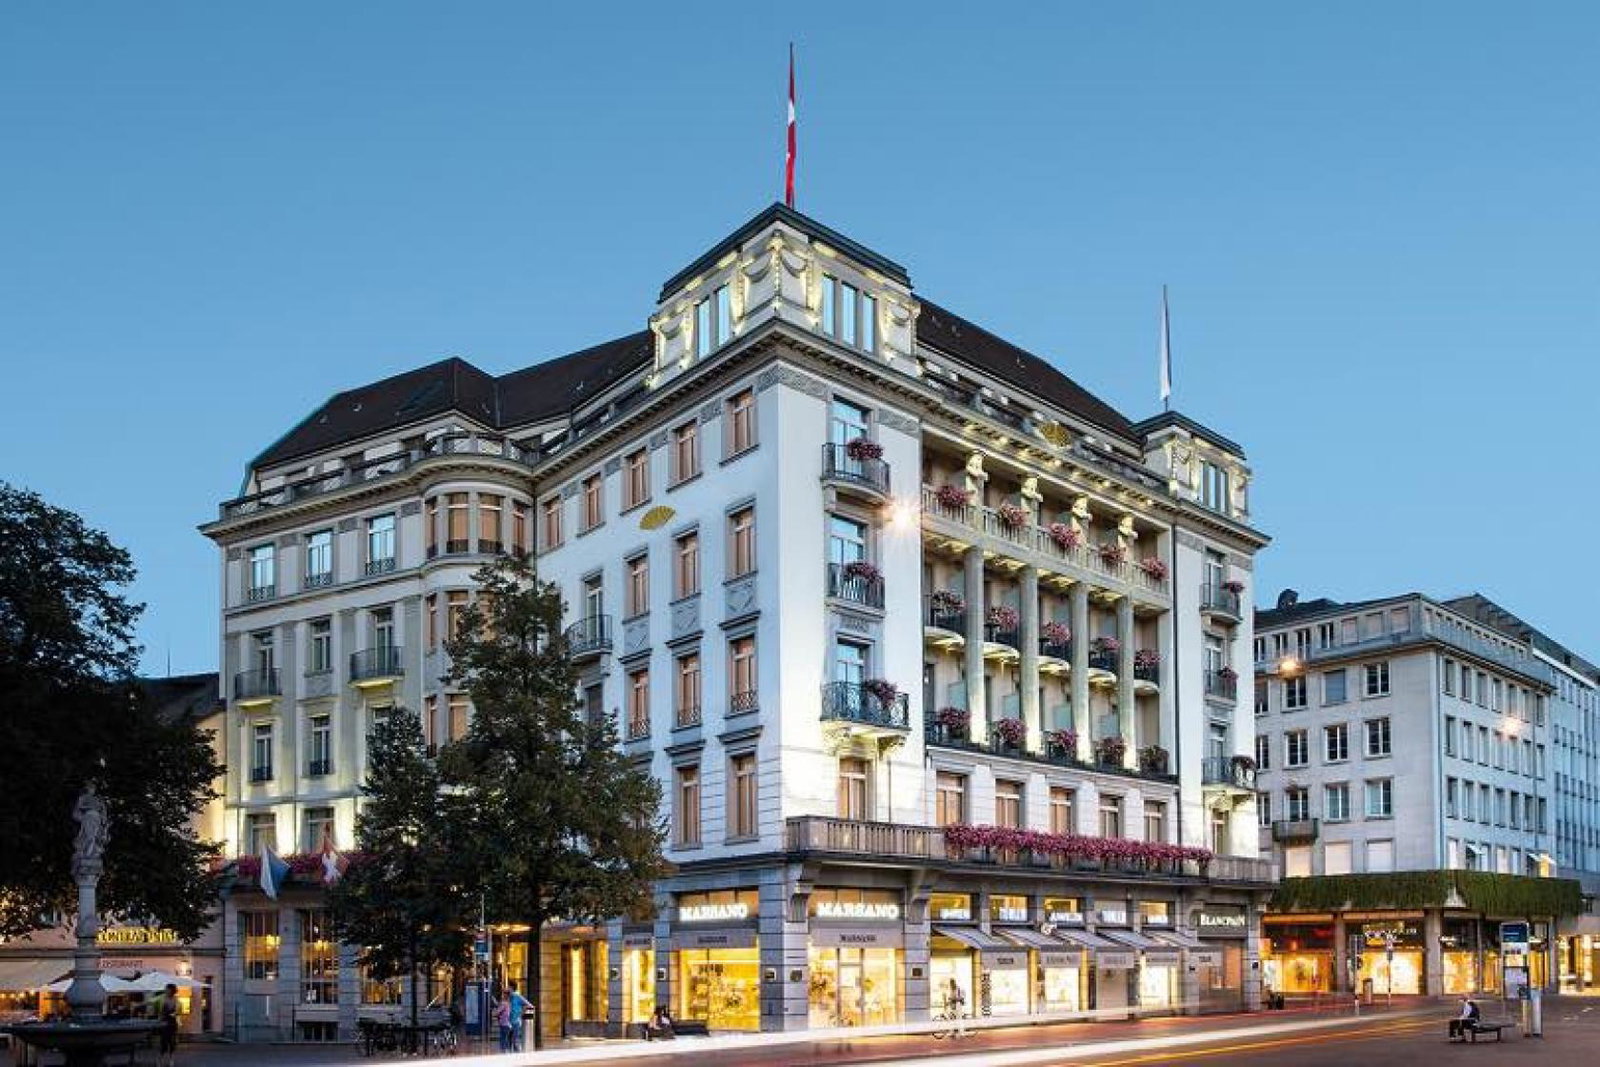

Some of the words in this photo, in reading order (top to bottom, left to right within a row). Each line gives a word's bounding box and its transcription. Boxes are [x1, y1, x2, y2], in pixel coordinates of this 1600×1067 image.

[680, 903, 748, 921] MARSANO
[817, 902, 899, 919] MARSANO
[1200, 914, 1246, 926] BLANCPAIN
